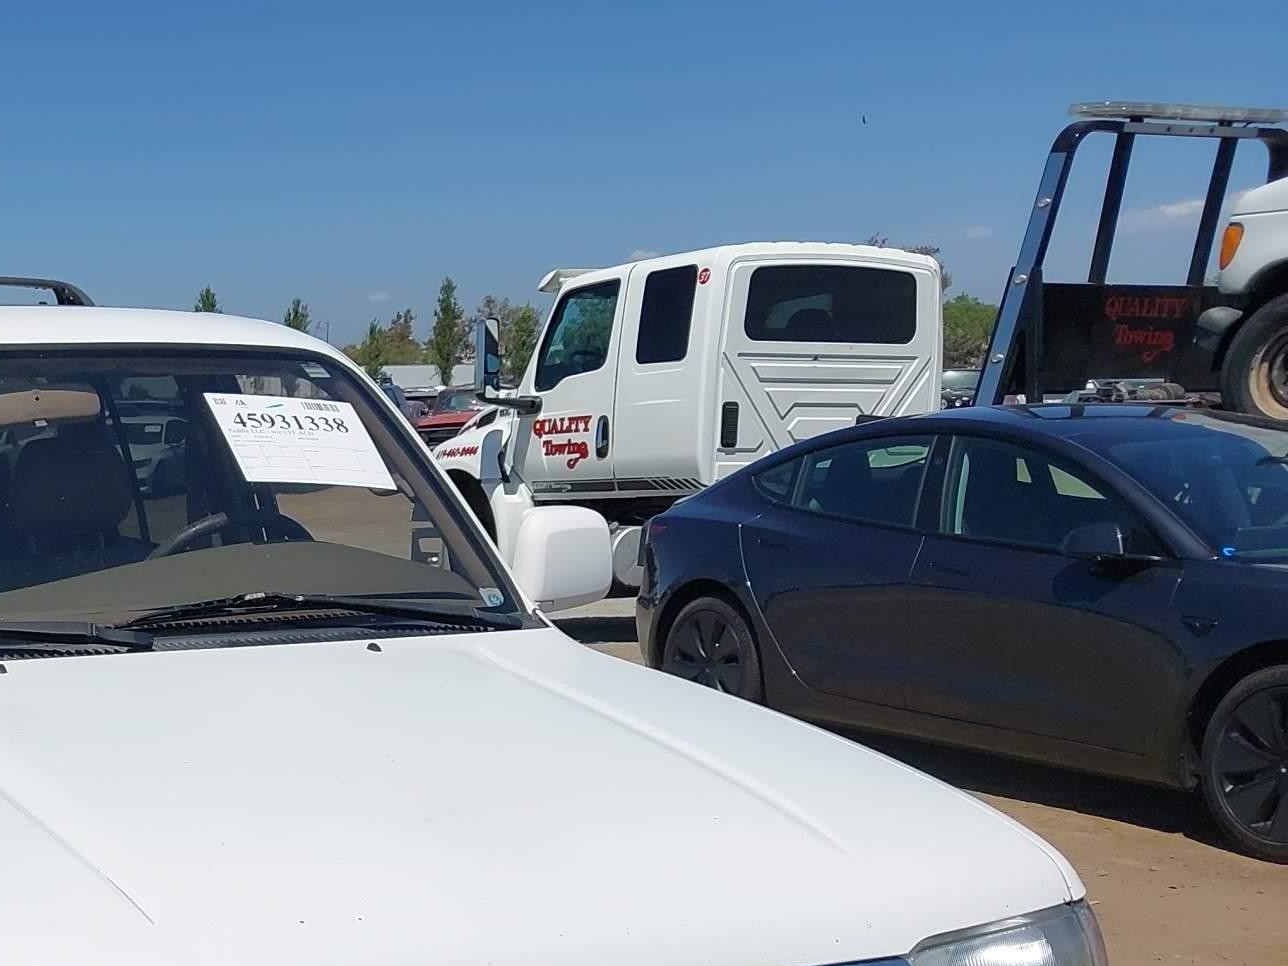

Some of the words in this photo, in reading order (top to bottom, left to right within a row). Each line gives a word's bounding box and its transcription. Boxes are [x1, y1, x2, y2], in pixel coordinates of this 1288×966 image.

[1105, 297, 1187, 320] QUALITY
[1115, 324, 1175, 363] Towing
[233, 412, 349, 434] 45931338
[533, 415, 593, 440] QUALITY
[543, 438, 590, 469] Towing
